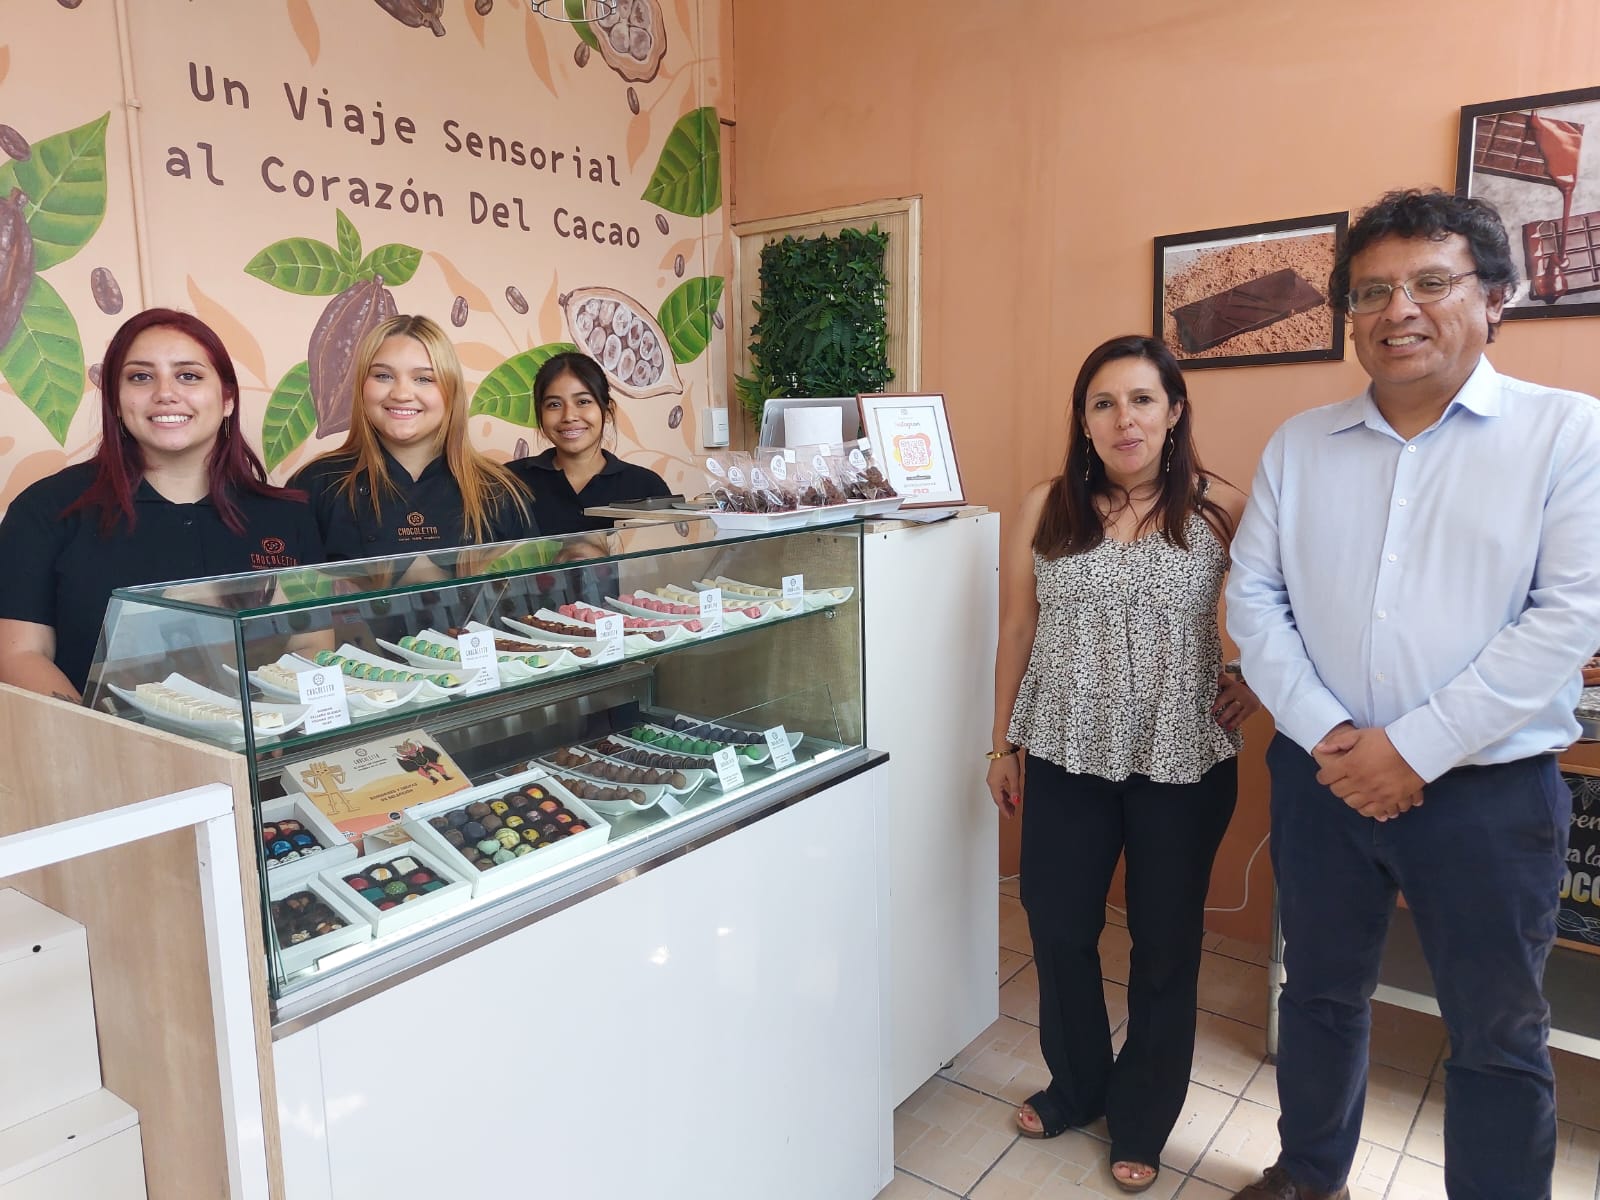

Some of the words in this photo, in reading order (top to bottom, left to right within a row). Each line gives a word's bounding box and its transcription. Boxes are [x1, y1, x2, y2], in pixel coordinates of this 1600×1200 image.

[189, 61, 249, 109] Un
[284, 82, 416, 146] Viaje
[443, 119, 621, 186] Sensorial
[166, 142, 224, 186] al
[261, 156, 443, 217] Corazón
[470, 191, 531, 231] Del
[553, 207, 640, 248] Cacao
[398, 527, 438, 536] CHOCOLETTO
